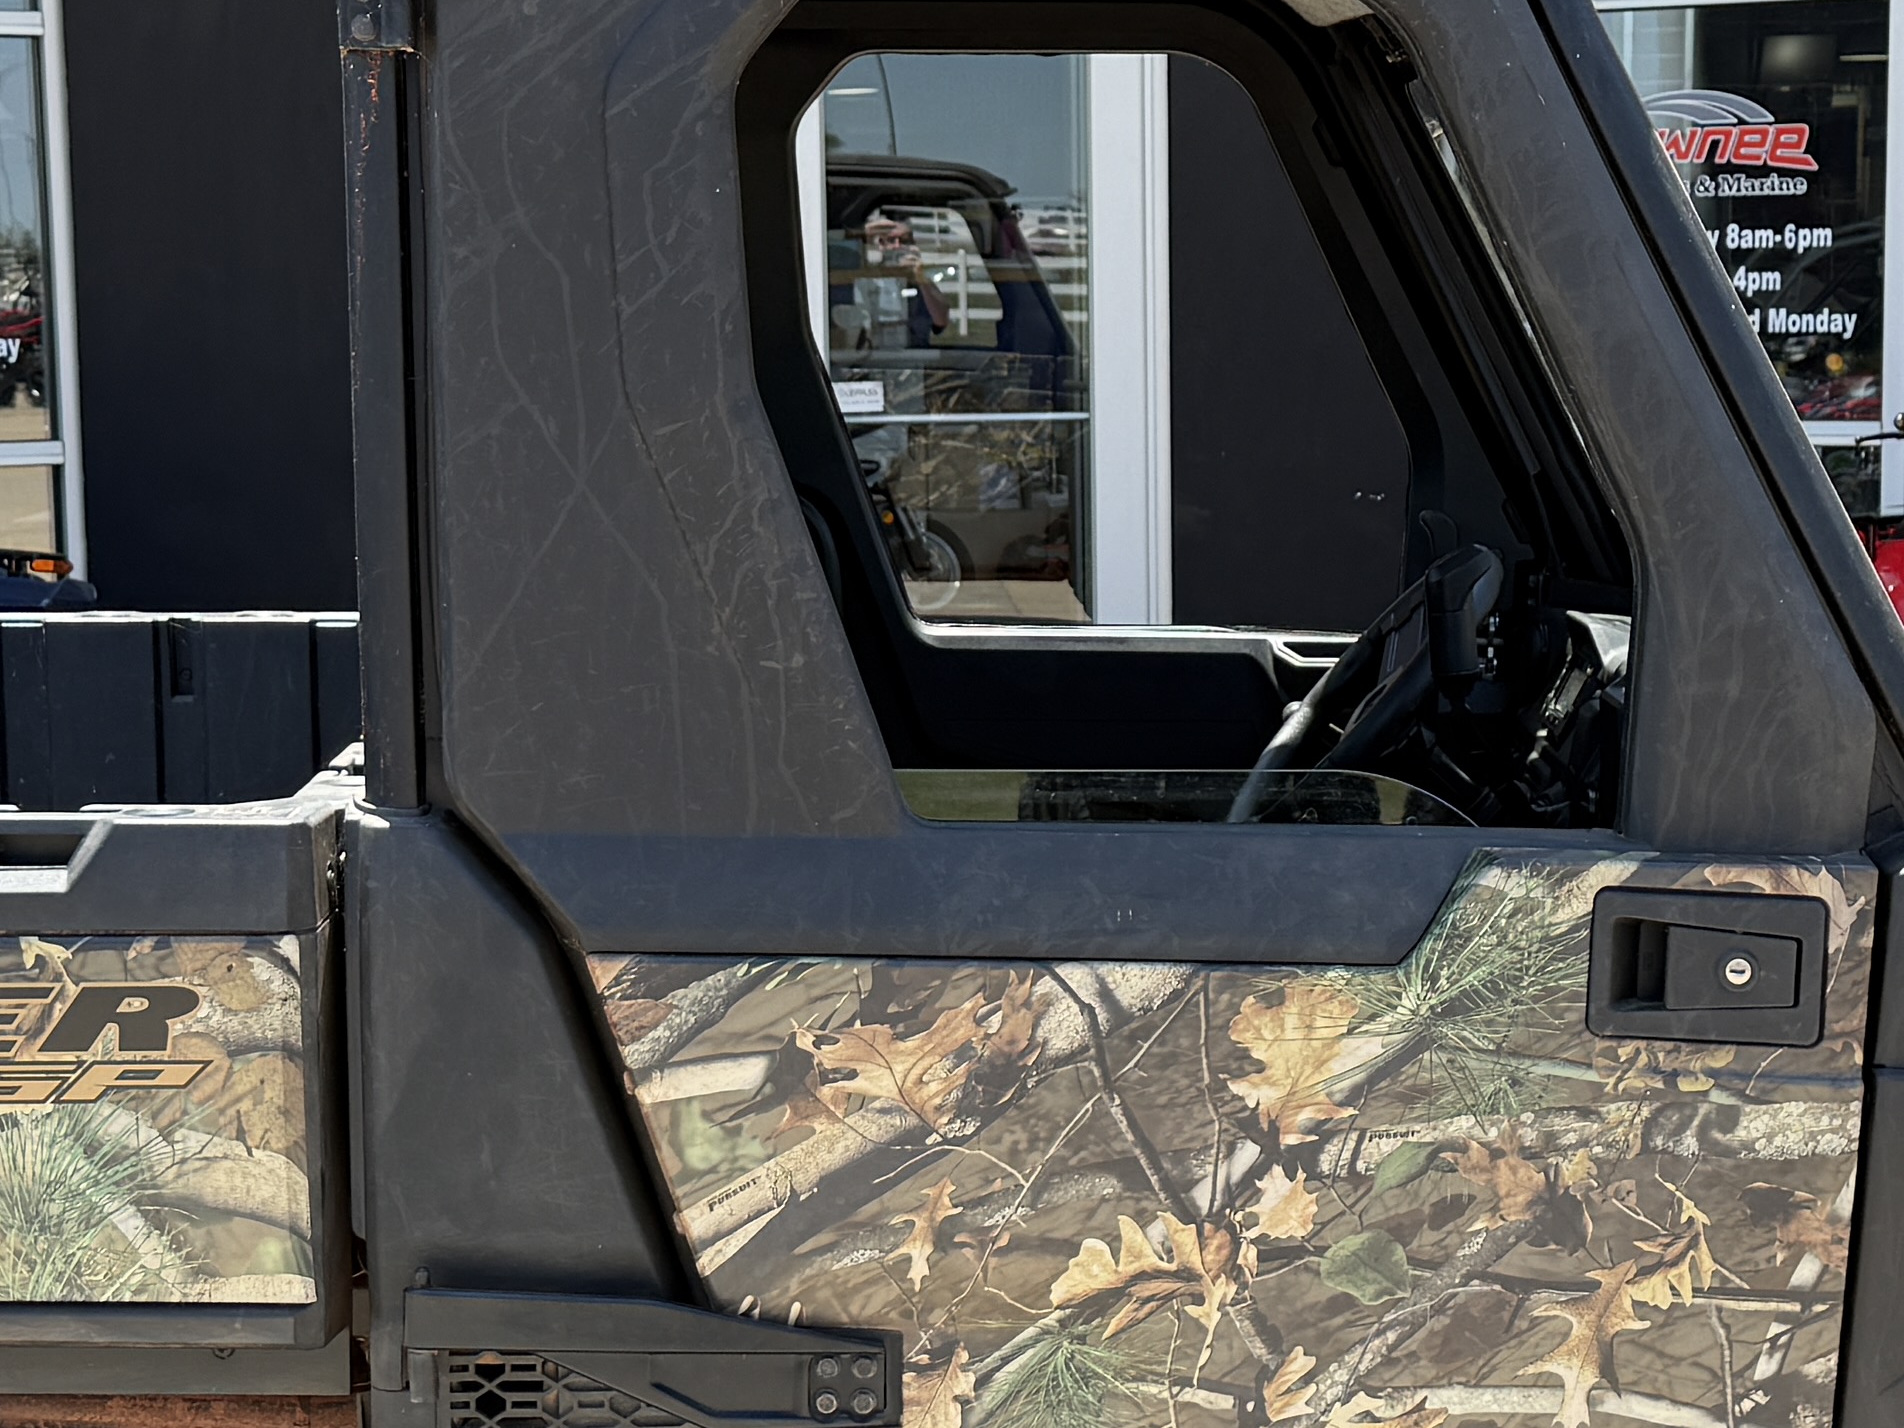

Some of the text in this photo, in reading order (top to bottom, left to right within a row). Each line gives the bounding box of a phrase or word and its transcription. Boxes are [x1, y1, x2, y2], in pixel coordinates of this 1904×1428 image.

[1695, 174, 1716, 197] &
[1717, 172, 1808, 197] Marine
[1725, 222, 1833, 255] 8am-6pm
[1766, 306, 1858, 340] Monday
